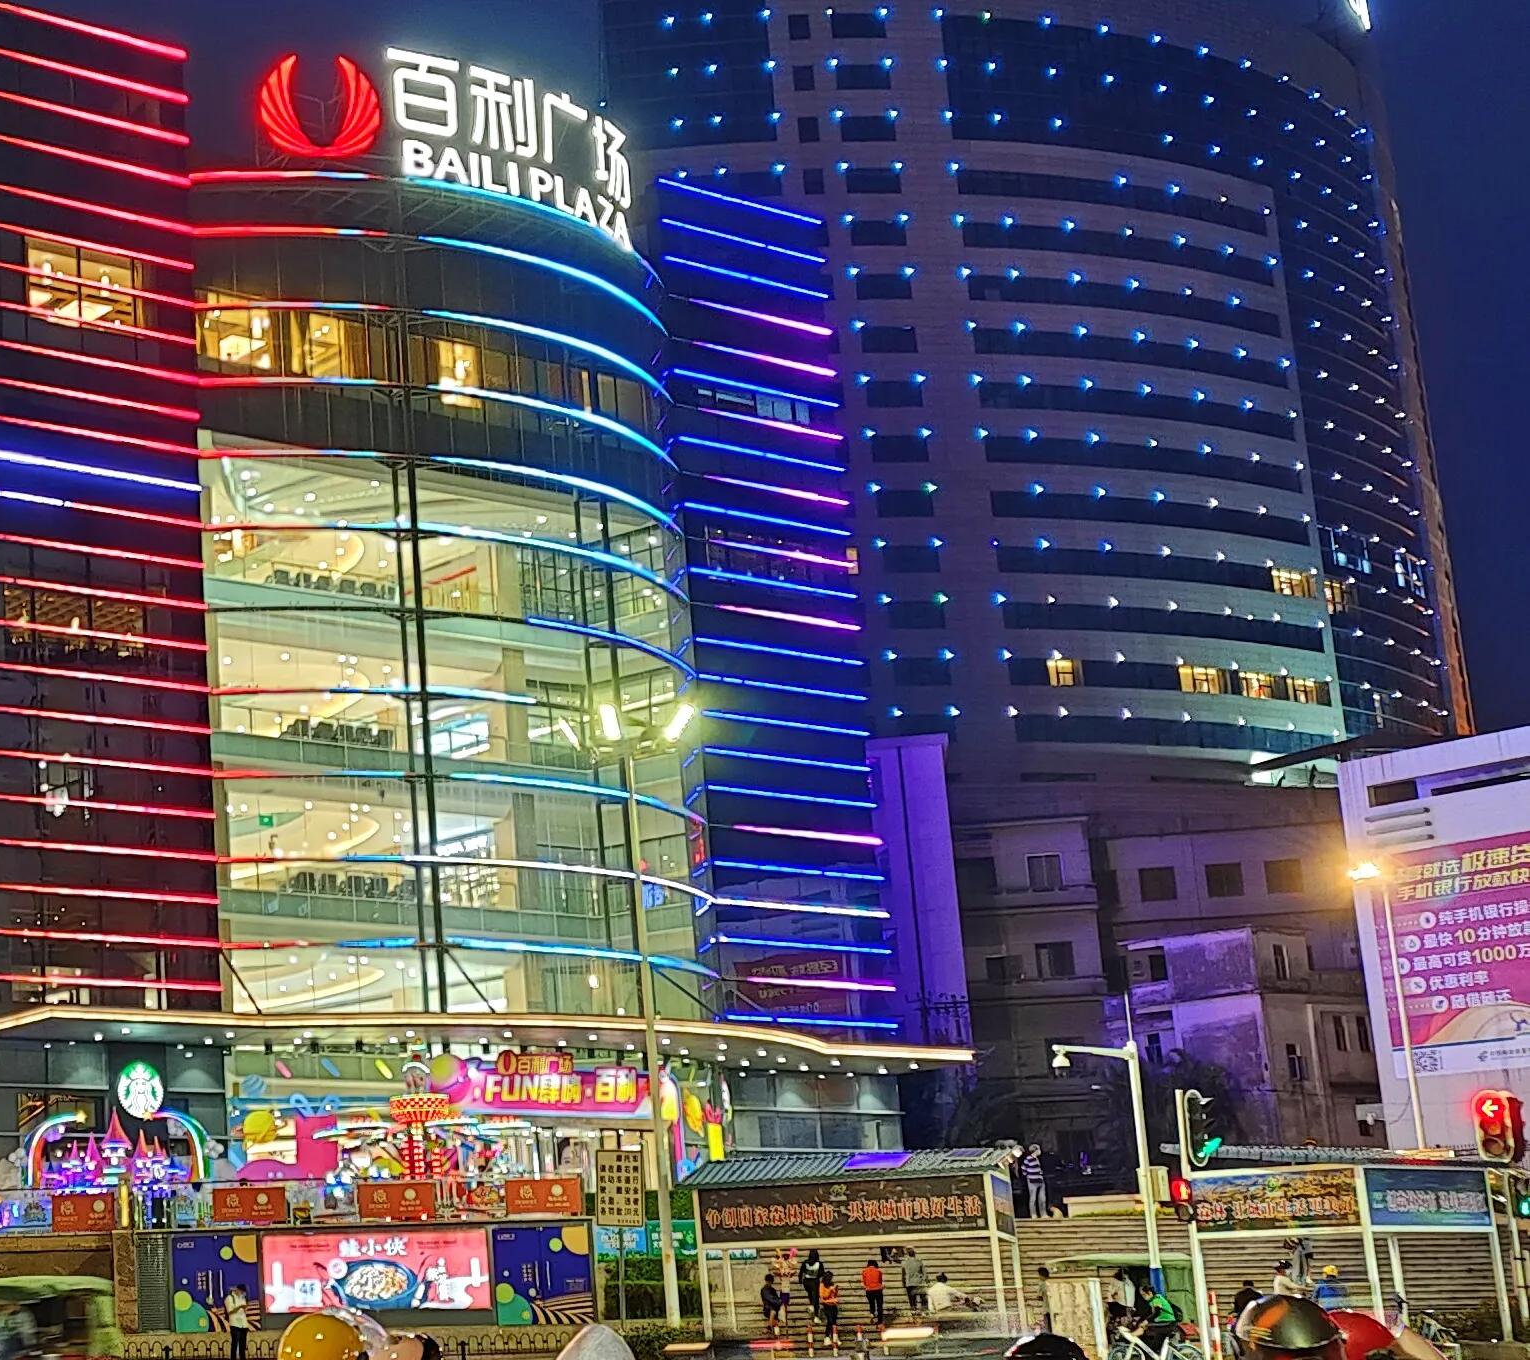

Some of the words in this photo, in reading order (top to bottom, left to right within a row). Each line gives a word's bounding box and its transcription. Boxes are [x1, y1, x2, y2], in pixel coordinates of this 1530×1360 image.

[386, 46, 634, 210] 百利广场
[401, 139, 521, 197] BAILI
[530, 167, 634, 252] PLAZA
[1438, 900, 1530, 926] 纯手机银行操
